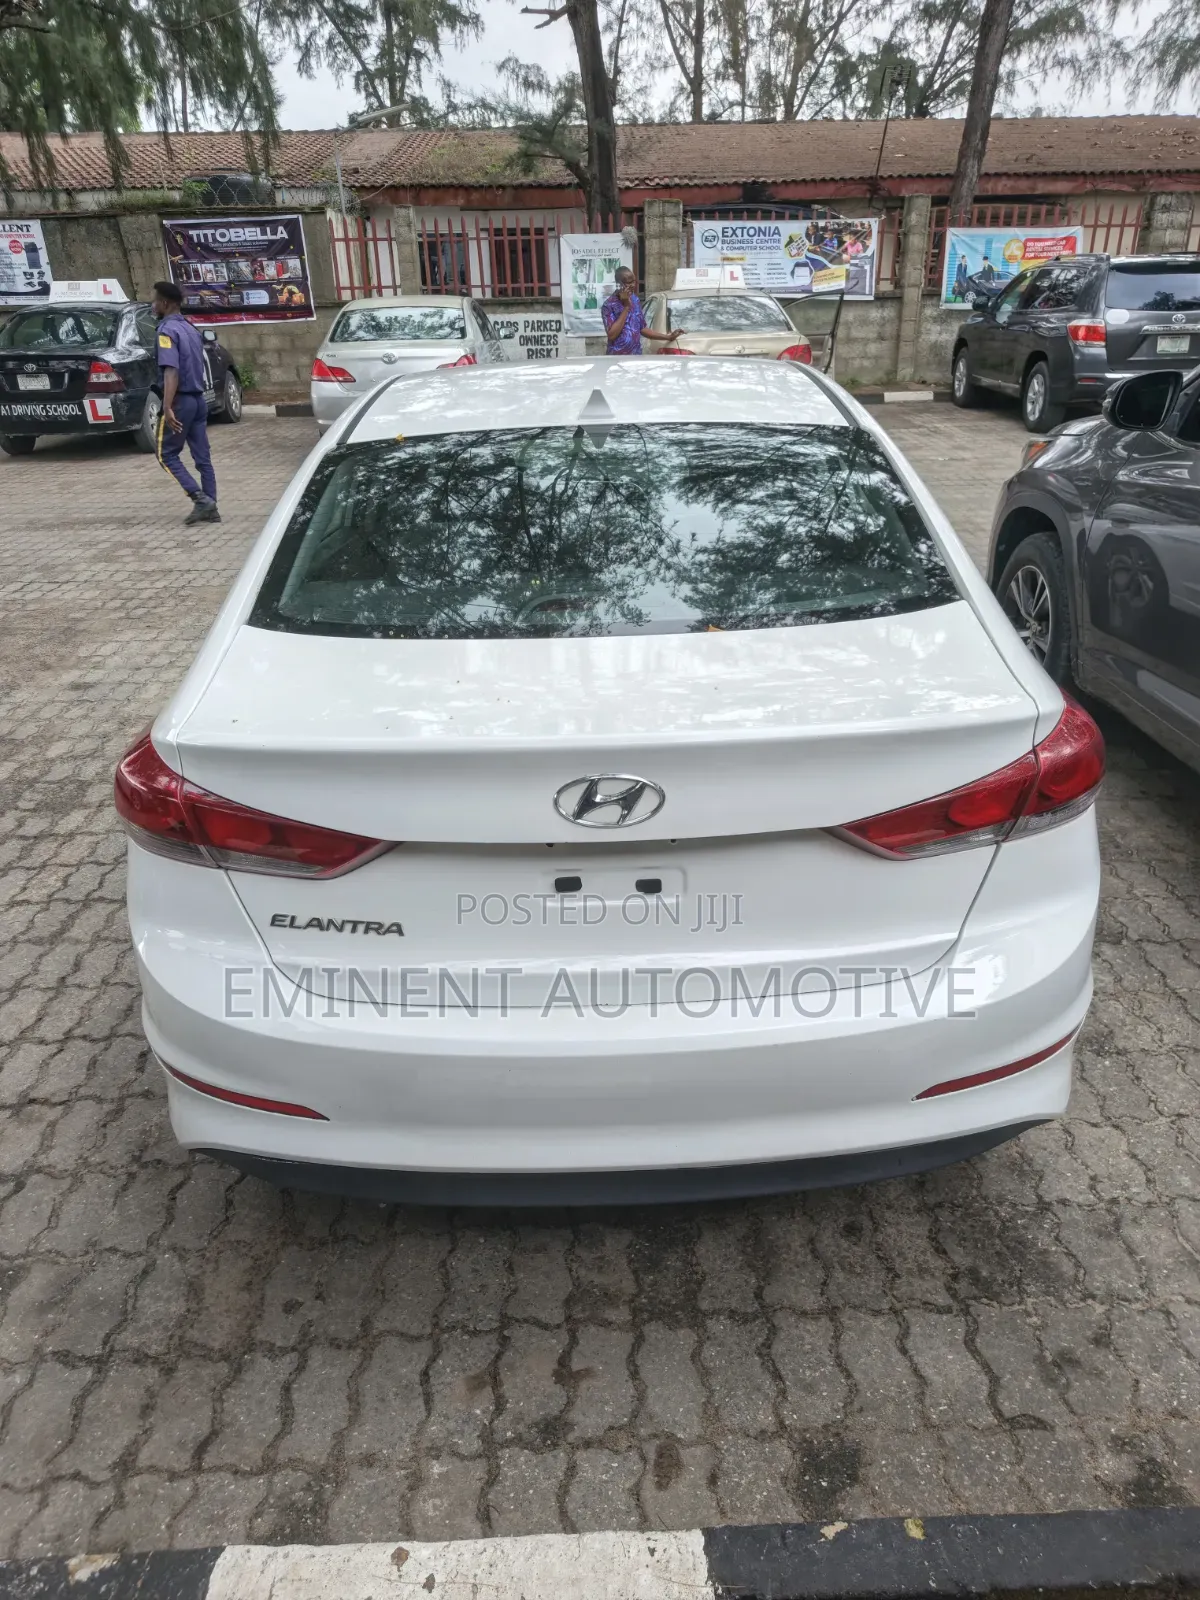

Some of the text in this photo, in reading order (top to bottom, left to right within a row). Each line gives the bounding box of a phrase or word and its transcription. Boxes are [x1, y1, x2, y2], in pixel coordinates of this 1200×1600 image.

[188, 226, 289, 243] TITOBELLA
[722, 226, 782, 238] EXTONIA
[730, 270, 739, 281] L
[102, 283, 112, 295] L
[523, 319, 562, 333] PARKED
[519, 333, 559, 346] OWNERS
[1, 403, 82, 416] A1 DRIVING SCHOOL
[89, 399, 113, 421] L
[270, 913, 405, 937] ELANTRA
